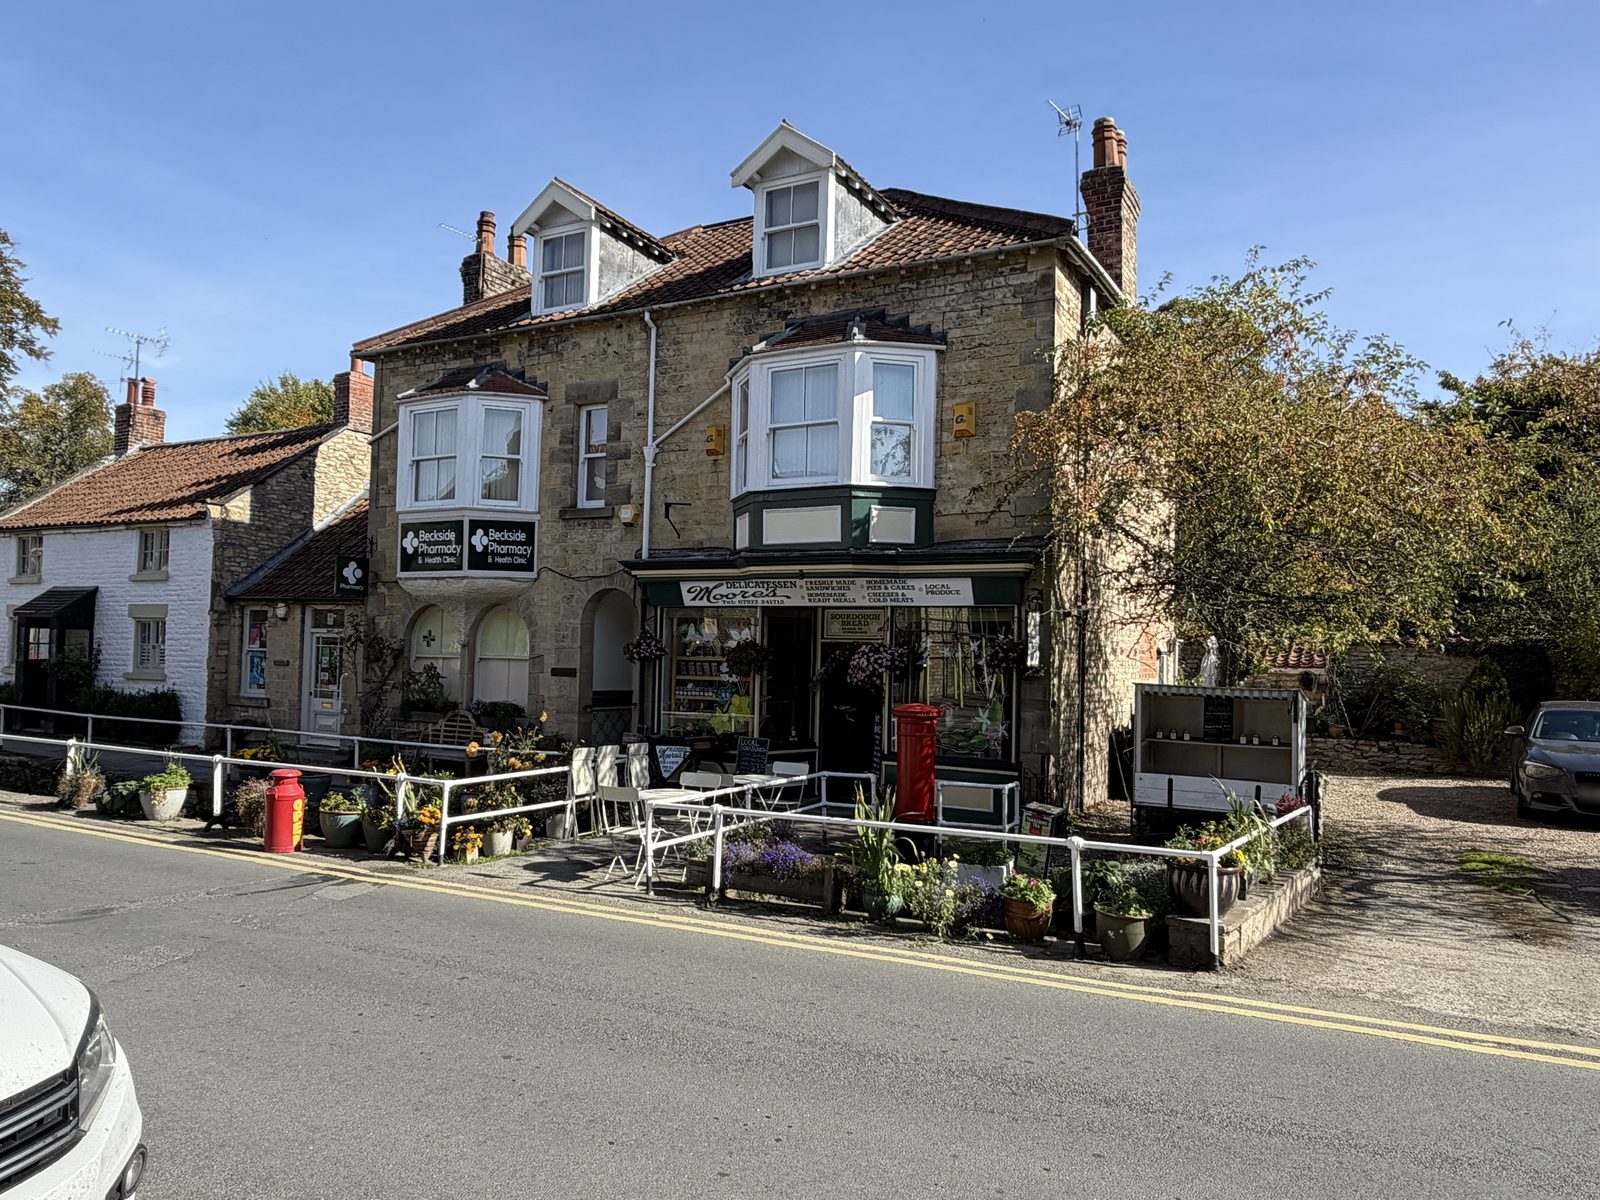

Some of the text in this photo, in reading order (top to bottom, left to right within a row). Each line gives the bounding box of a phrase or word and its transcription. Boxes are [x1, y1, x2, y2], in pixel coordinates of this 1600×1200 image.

[419, 529, 455, 542] Beckside
[488, 528, 526, 541] Beckside
[418, 543, 462, 556] Pharmacy
[488, 542, 532, 557] Pharmacy
[424, 555, 442, 564] Health
[442, 555, 457, 564] Clinic
[488, 555, 527, 565] & Health Clinic
[339, 582, 364, 591] Pharmacy
[725, 580, 797, 590] DELICATESSEN
[686, 582, 791, 604] Moore's
[830, 613, 881, 621] SOURDOUGH
